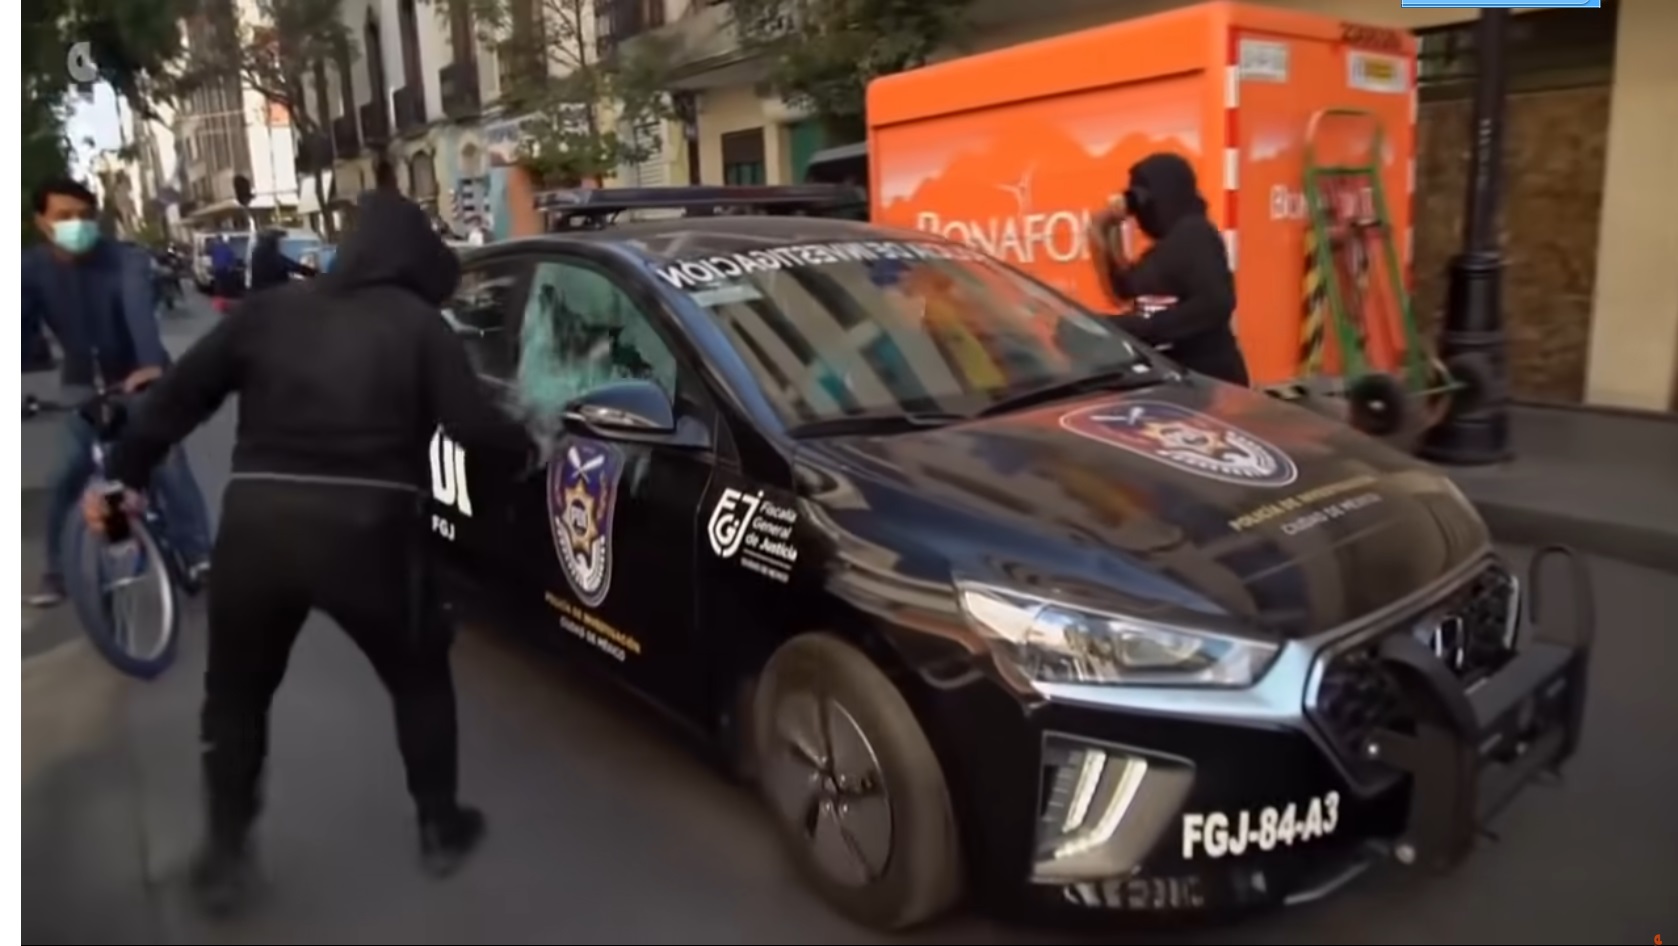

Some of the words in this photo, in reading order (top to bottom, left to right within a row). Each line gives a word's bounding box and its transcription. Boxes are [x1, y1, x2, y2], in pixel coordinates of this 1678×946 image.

[431, 514, 456, 541] FGJ
[752, 516, 792, 541] General
[744, 532, 760, 548] de
[760, 536, 798, 562] Justicia
[1182, 790, 1340, 860] FGJ-84-A3
